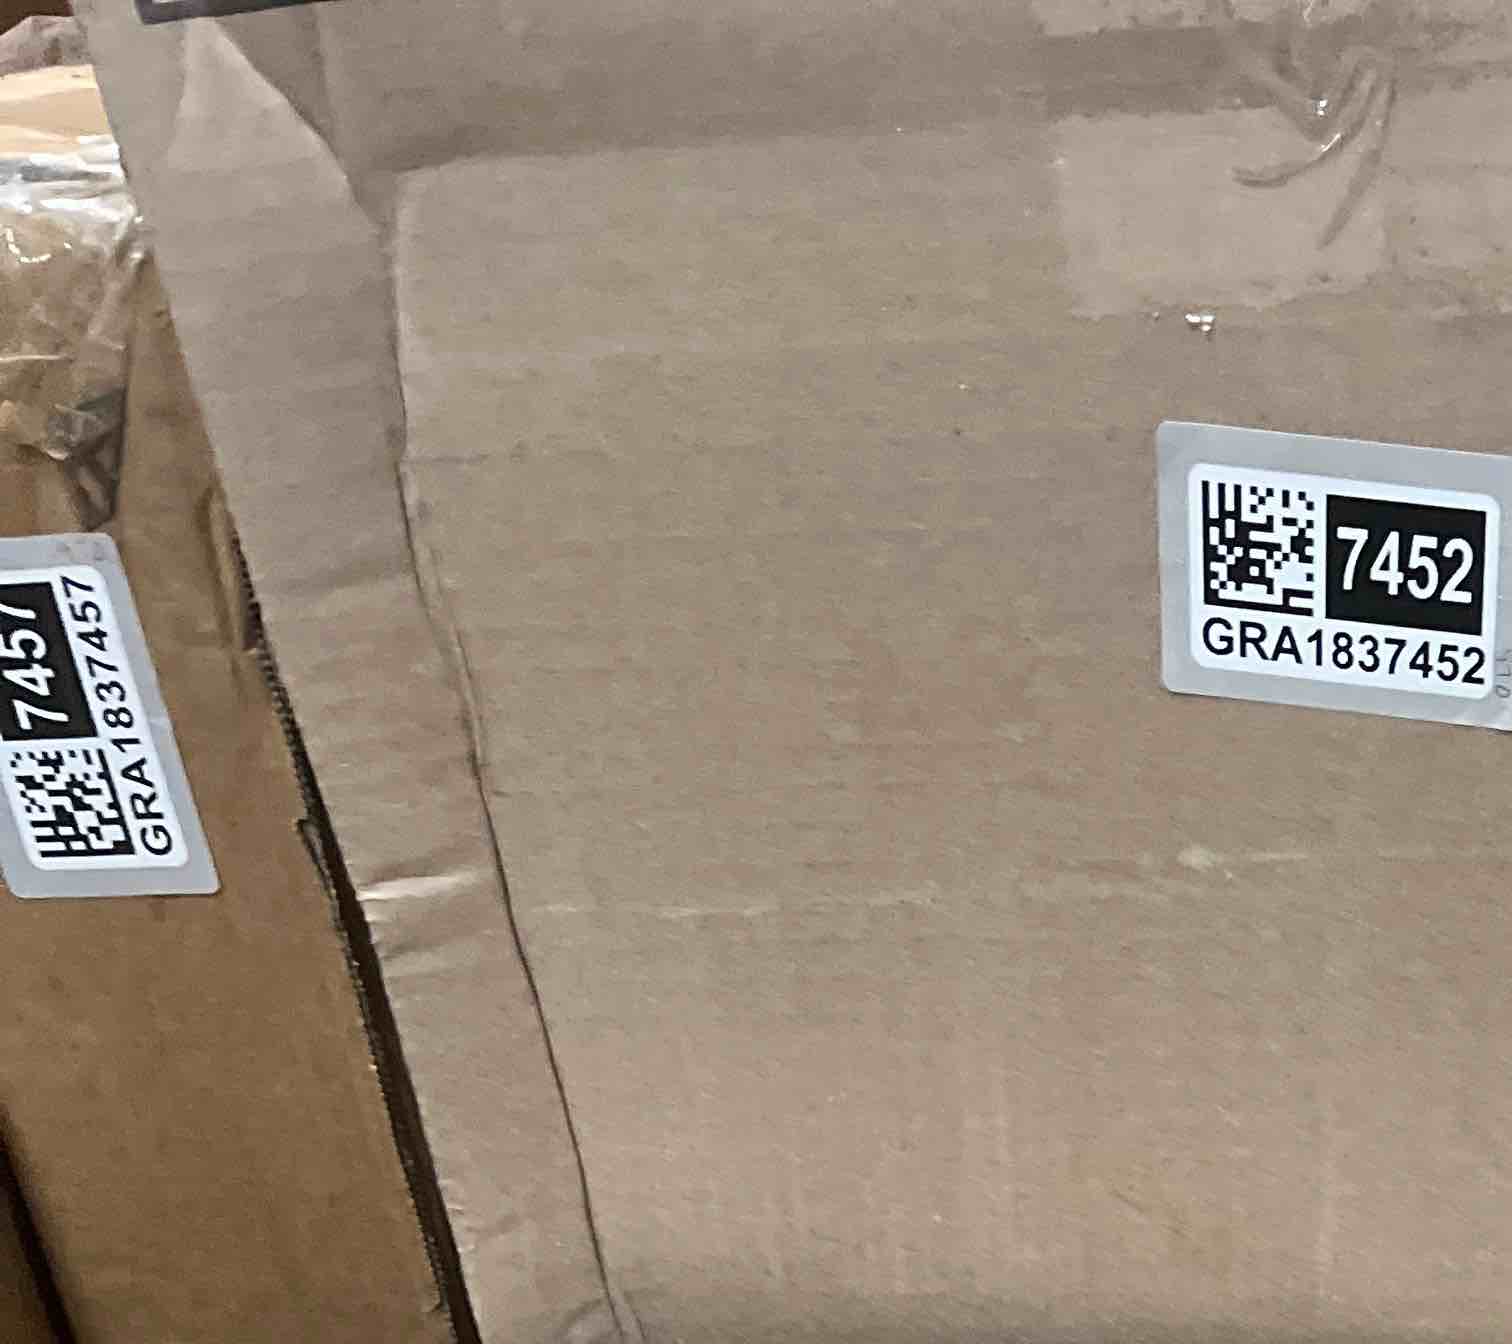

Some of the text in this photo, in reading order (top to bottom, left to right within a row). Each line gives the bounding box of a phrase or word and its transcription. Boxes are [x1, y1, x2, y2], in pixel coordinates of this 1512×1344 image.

[1337, 526, 1475, 604] 7452
[1202, 617, 1485, 685] GRA1837452
[60, 575, 173, 856] GRA1837457
